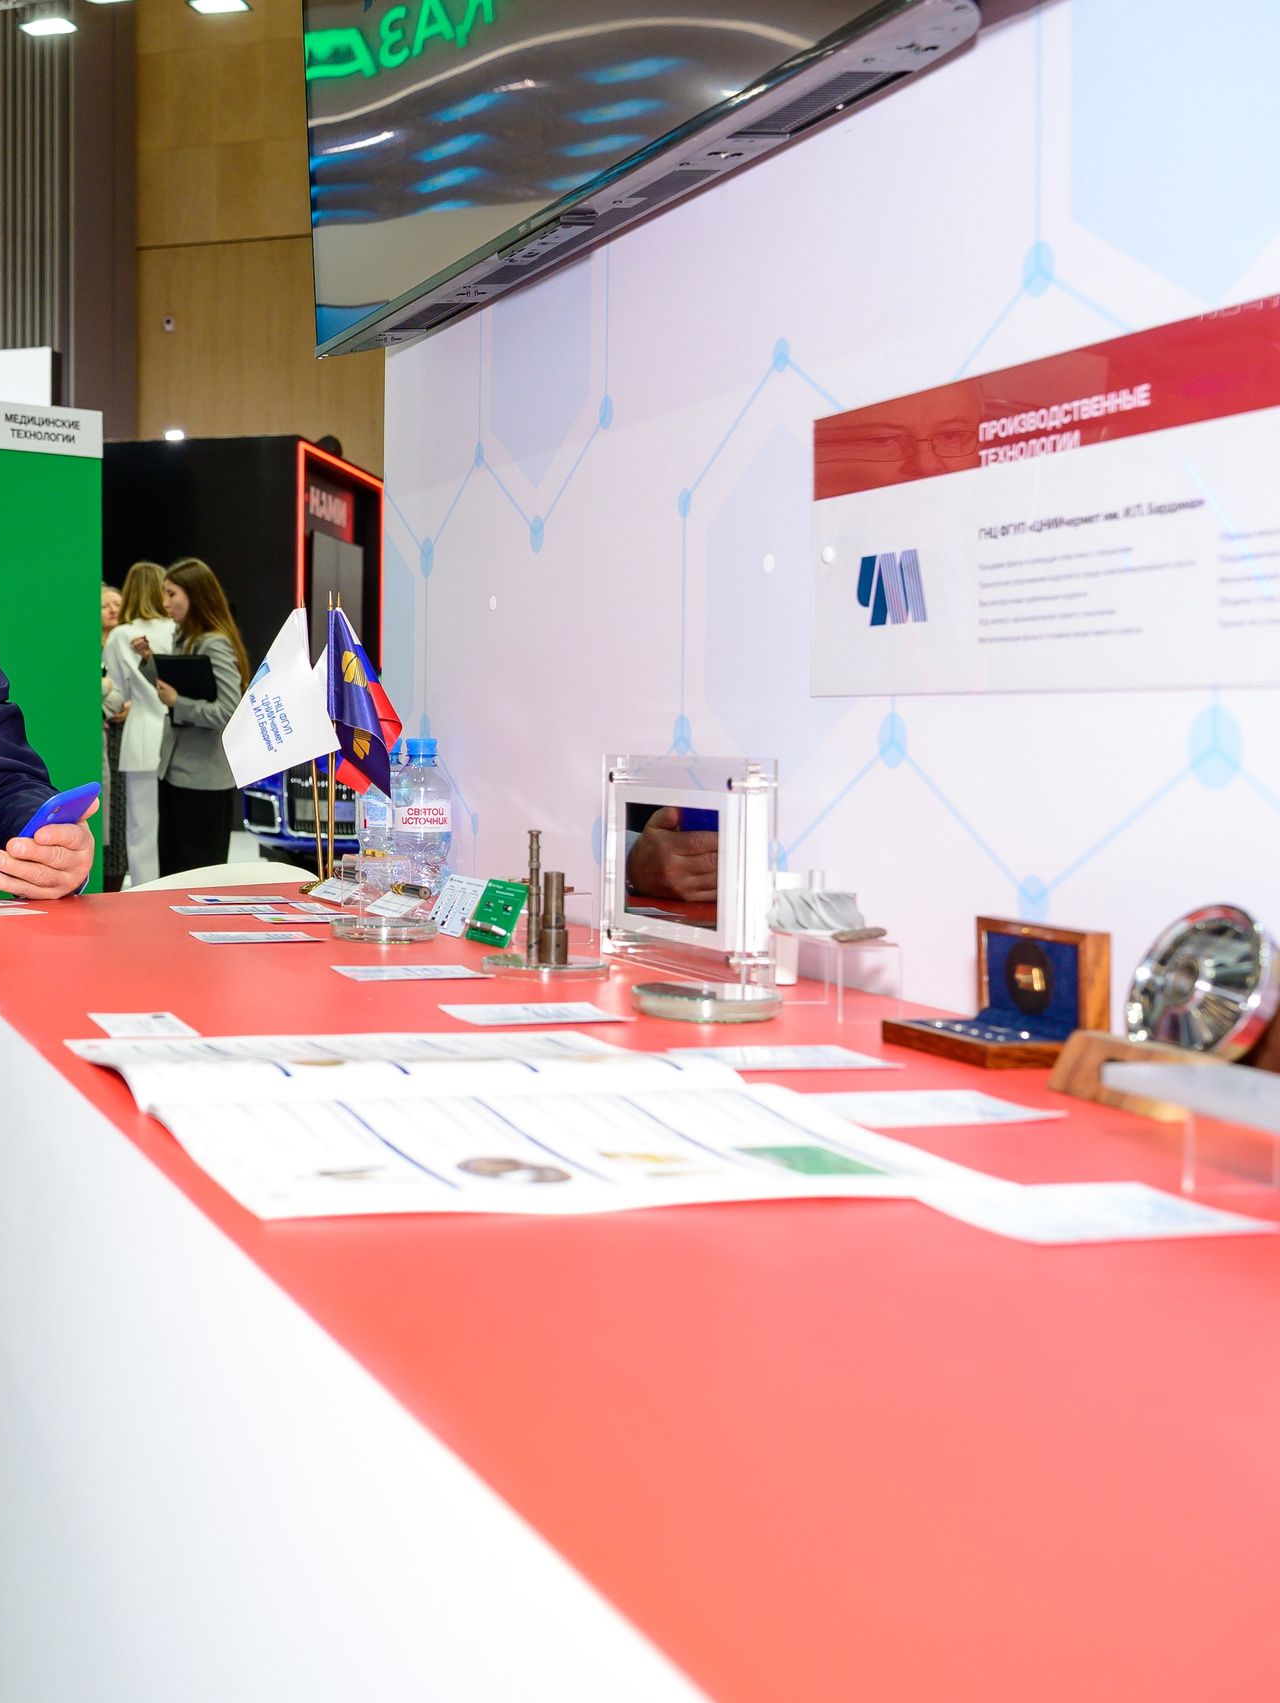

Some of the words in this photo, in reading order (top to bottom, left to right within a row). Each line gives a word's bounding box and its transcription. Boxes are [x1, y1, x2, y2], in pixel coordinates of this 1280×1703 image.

[978, 383, 1152, 442] ПРОИЗВОДСТВЕННЫЕ
[4, 413, 81, 431] МЕДИЦИНСКИЕ
[10, 428, 76, 444] ТЕХНОЛОГИИ
[978, 429, 1082, 468] ТЕХНОЛОГИИ
[272, 695, 284, 713] ГНЦ
[280, 712, 293, 735] ФГУП
[407, 807, 444, 816] СВЯТОЙ
[402, 817, 448, 825] ИСТОЧНИК
